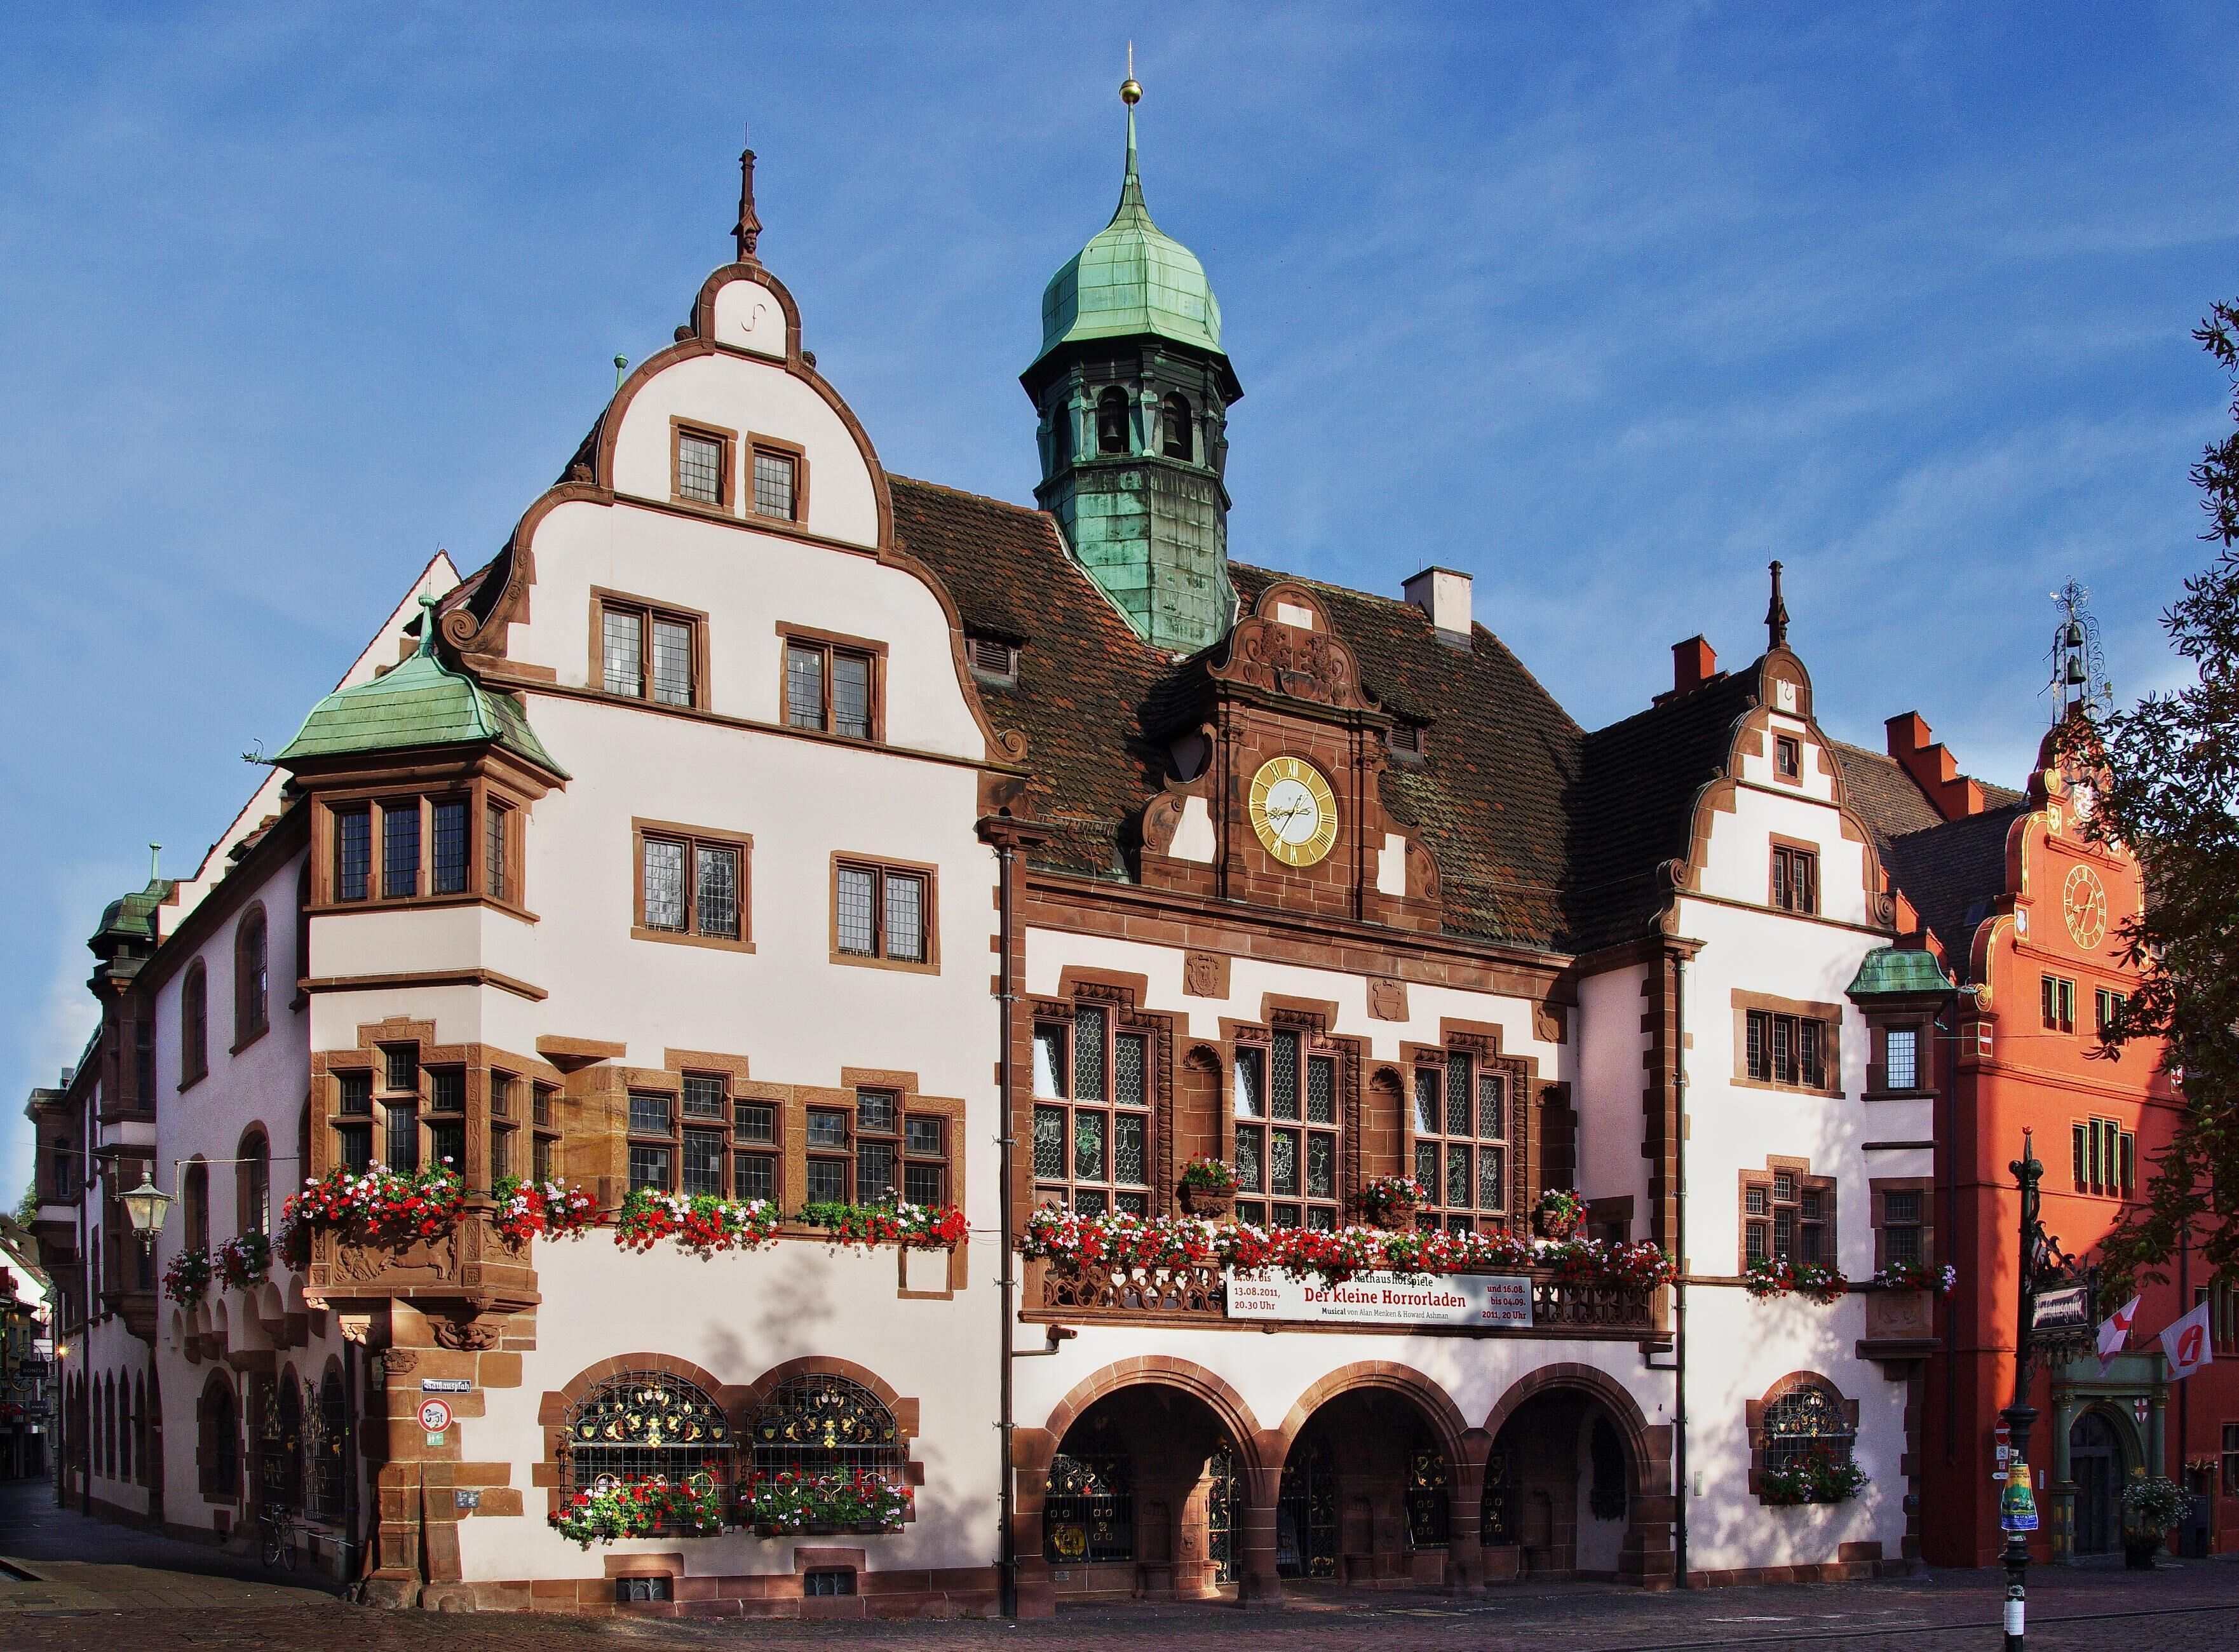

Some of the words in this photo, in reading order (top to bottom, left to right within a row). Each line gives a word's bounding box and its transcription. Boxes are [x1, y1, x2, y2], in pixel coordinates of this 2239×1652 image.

[1268, 761, 1282, 782] XI
[1287, 759, 1299, 778] XII
[1254, 776, 1270, 793] X
[1317, 790, 1332, 801] II
[1250, 799, 1266, 811] IX
[1321, 814, 1336, 824] III
[1259, 1273, 1271, 1282] bis
[1234, 1287, 1281, 1299] 13.08.2011,
[1487, 1284, 1501, 1293] und
[1503, 1285, 1525, 1294] 16.08.
[1304, 1287, 1330, 1302] Der
[1333, 1286, 1377, 1304] kleine
[1382, 1290, 1466, 1308] Horrorladen
[1491, 1296, 1502, 1305] bis
[1503, 1298, 1526, 1306] 04.09.
[1234, 1301, 1258, 1310] 20.30
[1259, 1301, 1276, 1310] Uhr
[1322, 1307, 1346, 1315] Musical
[1360, 1308, 1373, 1317] Alan
[1374, 1309, 1397, 1317] Menken
[1426, 1311, 1449, 1320] Ashman
[1482, 1311, 1501, 1320] 2011,
[1512, 1311, 1527, 1320] Uhr
